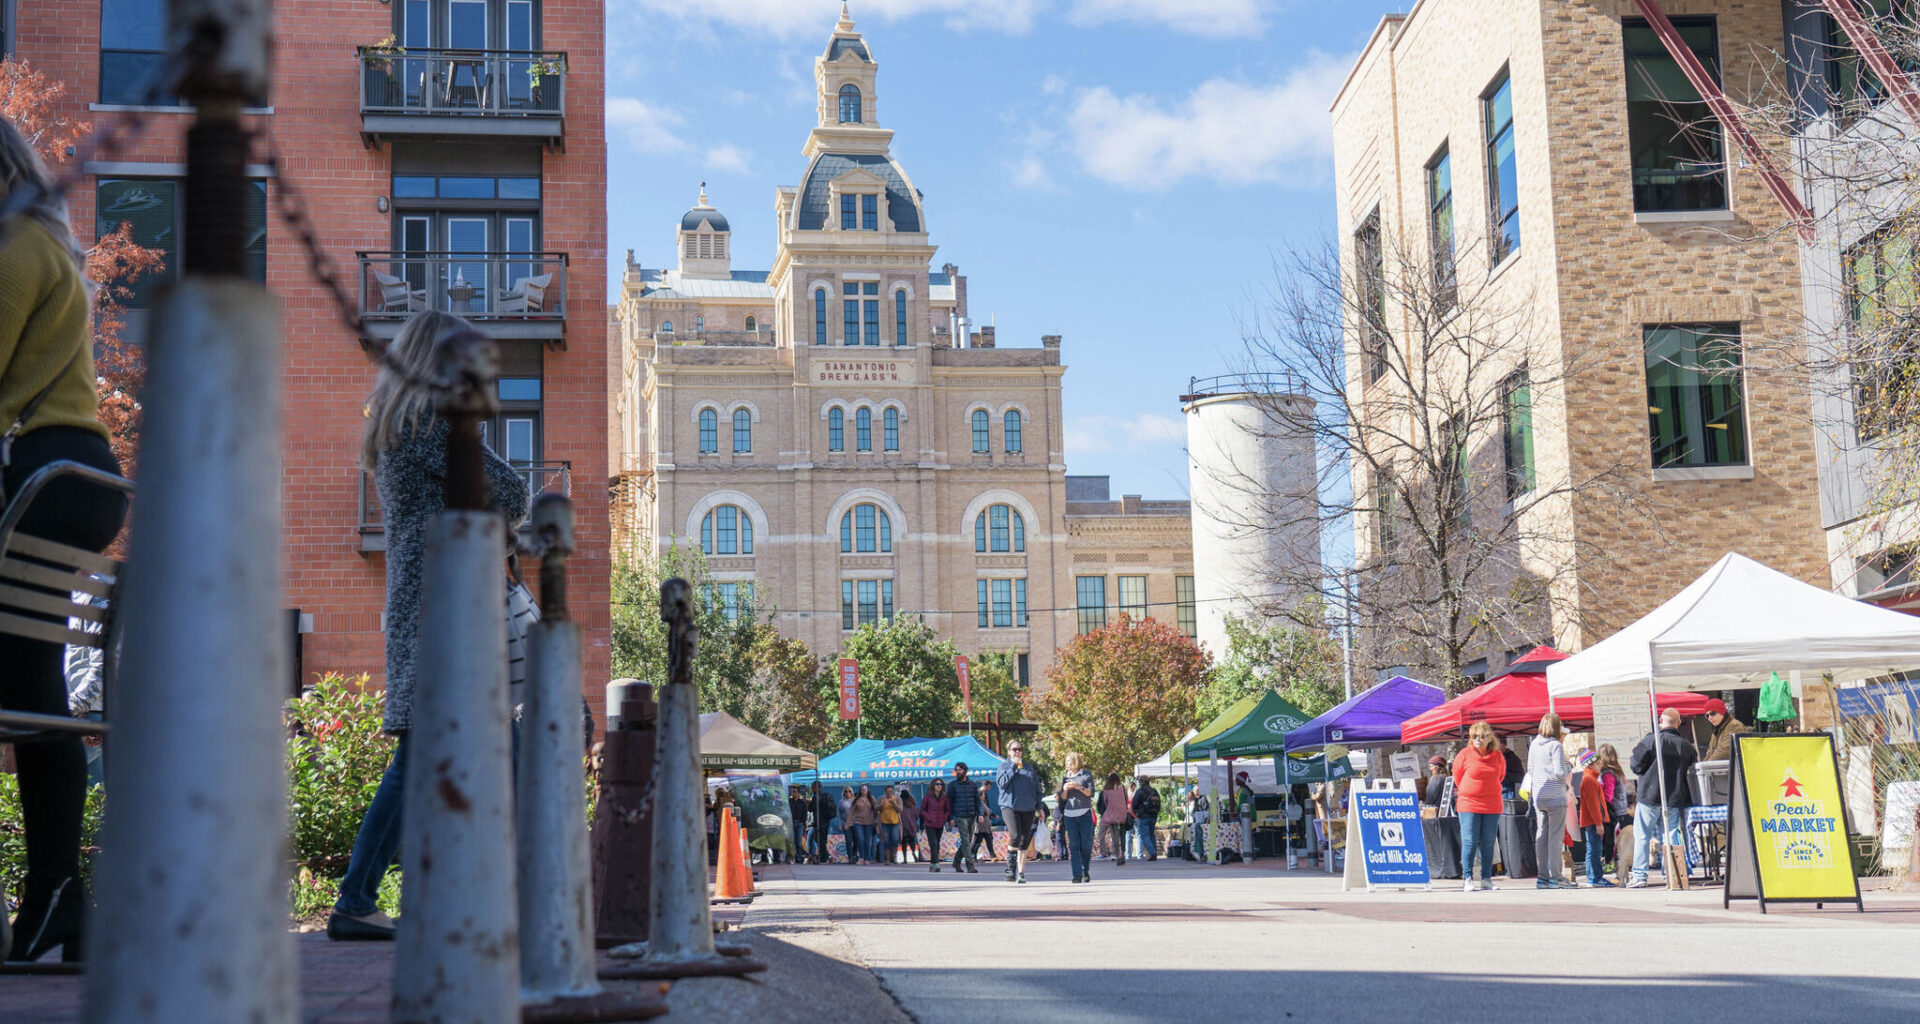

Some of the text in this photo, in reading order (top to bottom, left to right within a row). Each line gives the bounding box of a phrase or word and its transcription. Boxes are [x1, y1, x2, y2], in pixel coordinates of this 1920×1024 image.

[844, 666, 856, 712] INFO
[887, 747, 934, 759] Pearl
[870, 757, 950, 769] MARKET
[820, 771, 853, 779] MERCH
[874, 769, 944, 779] INFORMATION
[1361, 795, 1414, 806] Farmstead
[1362, 809, 1417, 819] Goat Cheese
[1774, 803, 1817, 815] Pearl
[1760, 817, 1836, 832] MARKET
[1784, 841, 1799, 859] LOCAL
[1368, 849, 1423, 866] Goat Milk Soap
